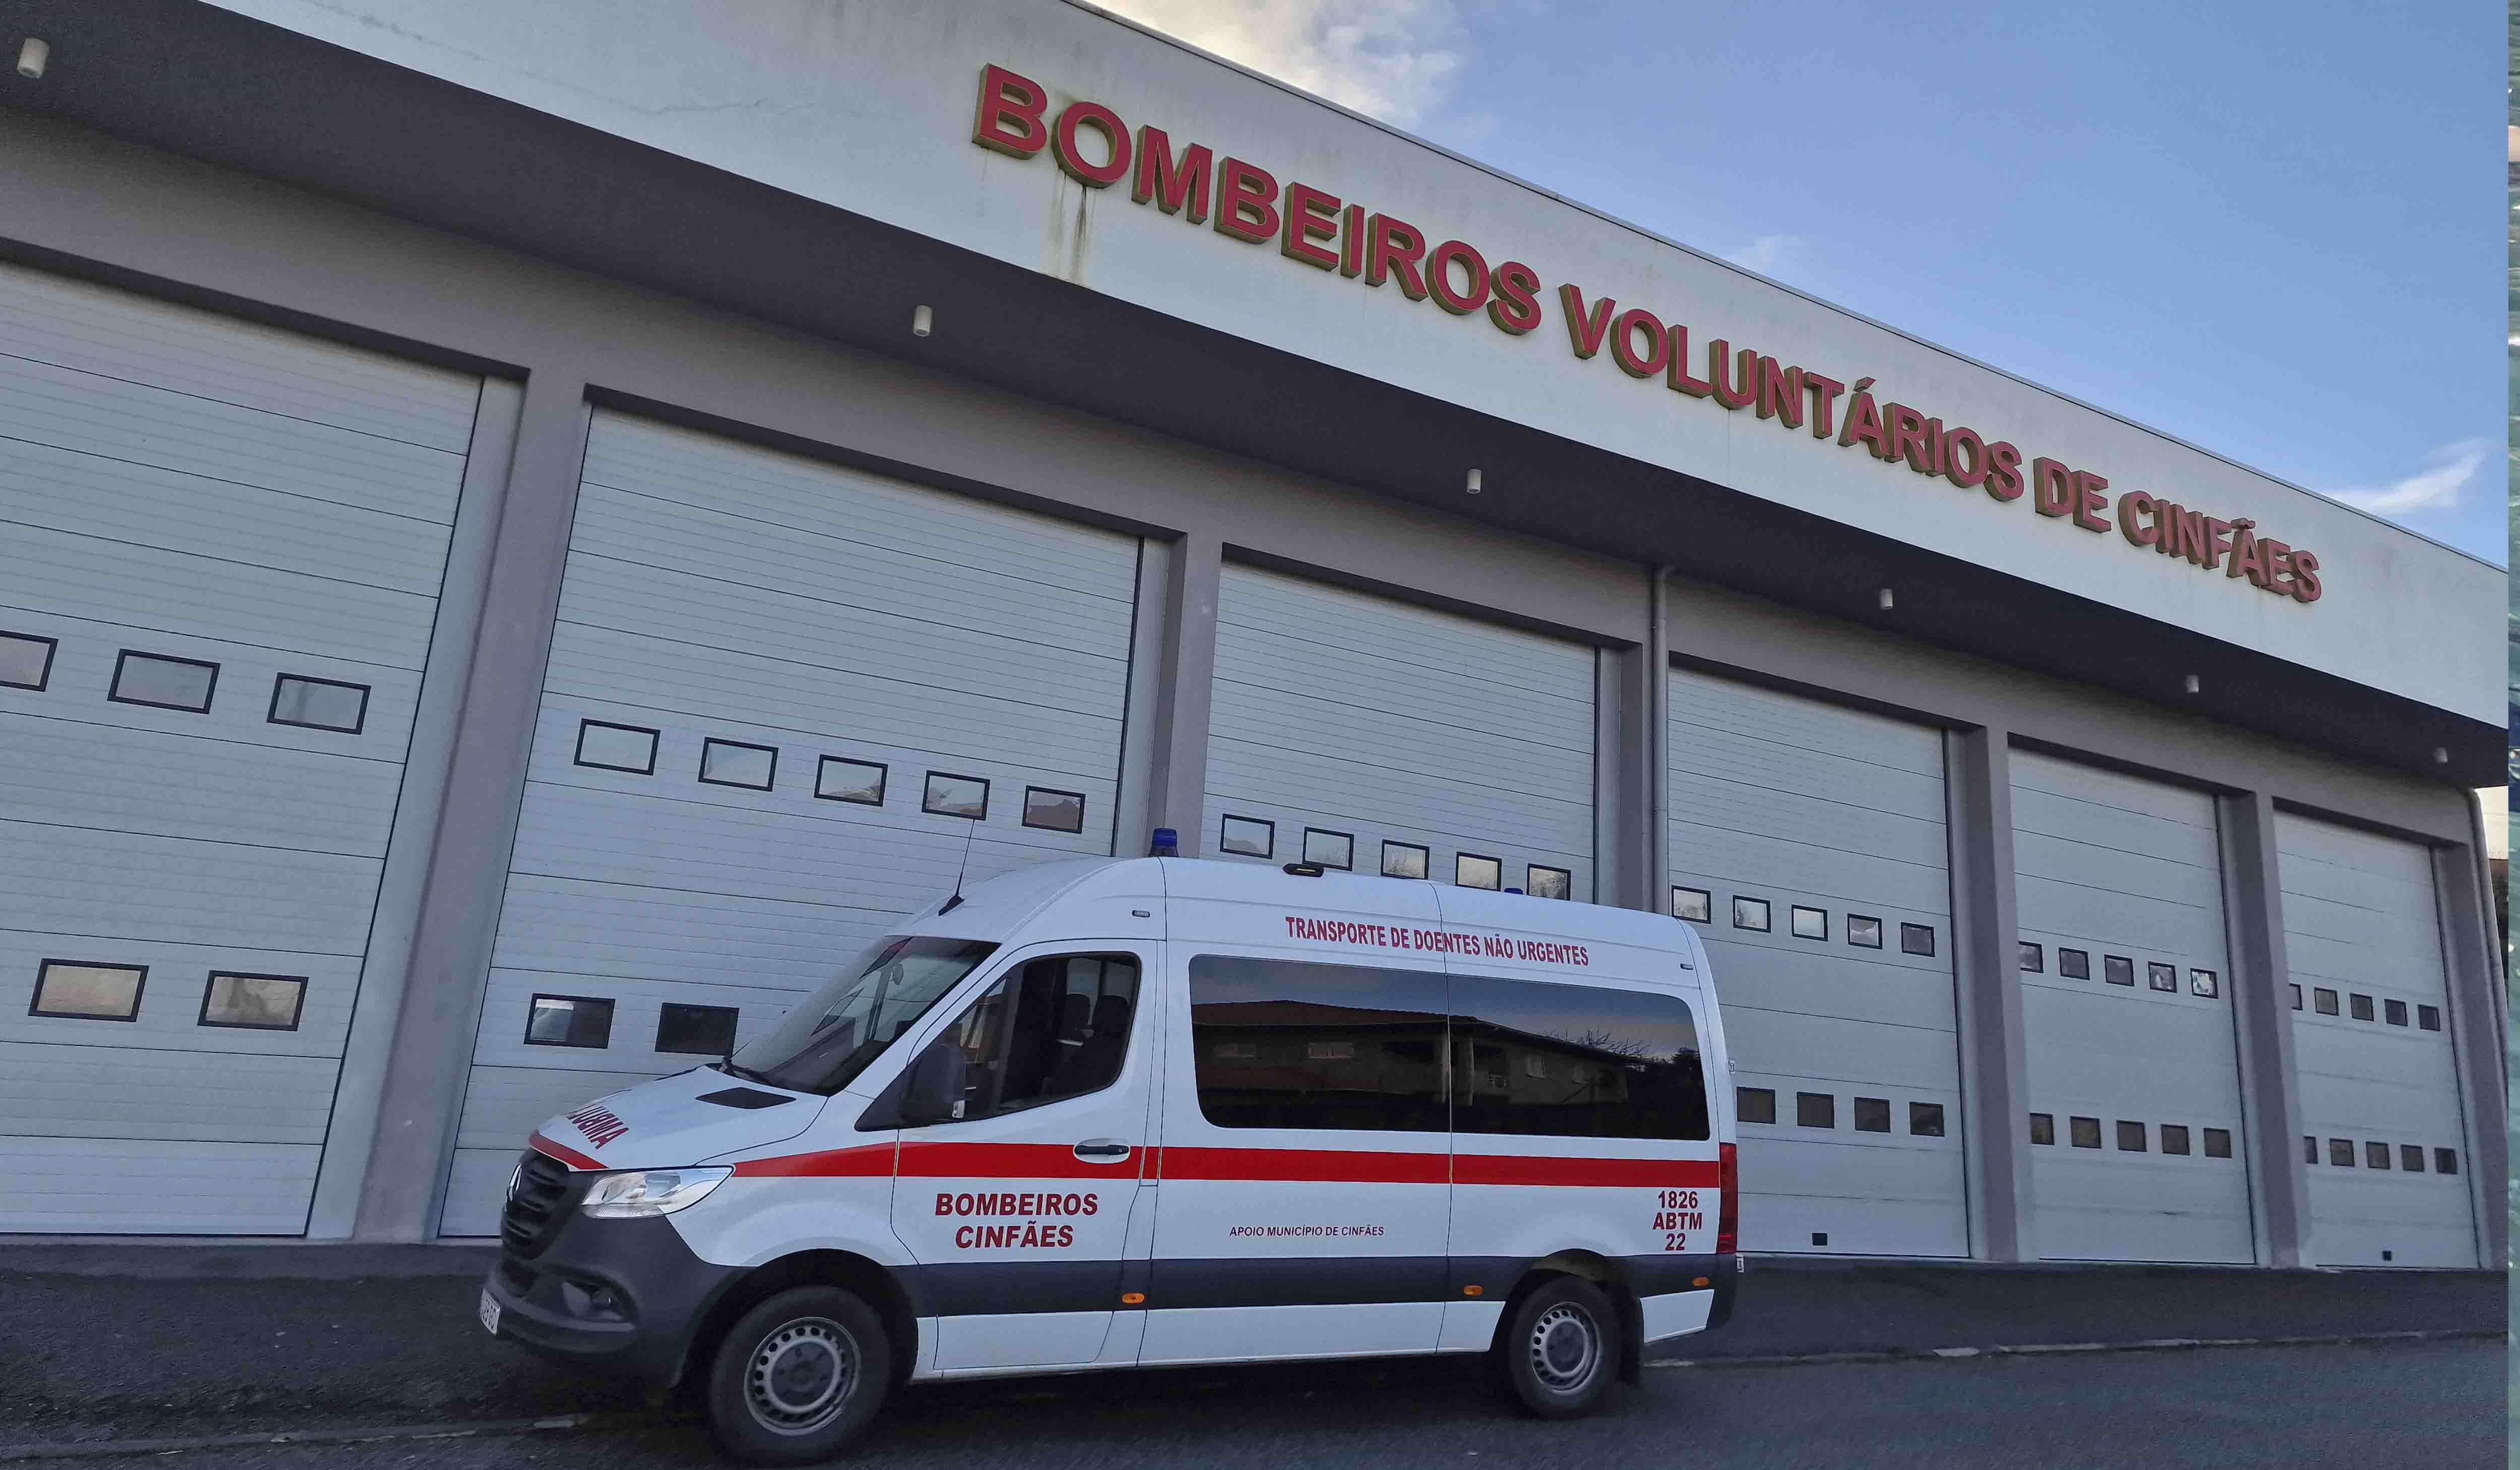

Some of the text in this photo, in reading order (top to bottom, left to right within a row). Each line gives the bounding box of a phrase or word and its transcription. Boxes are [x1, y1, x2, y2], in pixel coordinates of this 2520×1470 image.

[972, 63, 2321, 603] BOMBEIROS VOLUNTÁRIOS DE CINFÃES
[1285, 916, 1589, 967] TRANSPORTE DE DOENTES NÃO URGENTES
[935, 1193, 1098, 1216] BOMBEIROS
[1658, 1190, 1698, 1208] 1826
[1229, 1225, 1384, 1237] APOIO MUNICÍPIO DE CINFÃES
[1653, 1212, 1702, 1230] ABTM
[956, 1221, 1073, 1248] CINFÃES
[1665, 1233, 1686, 1251] 22
